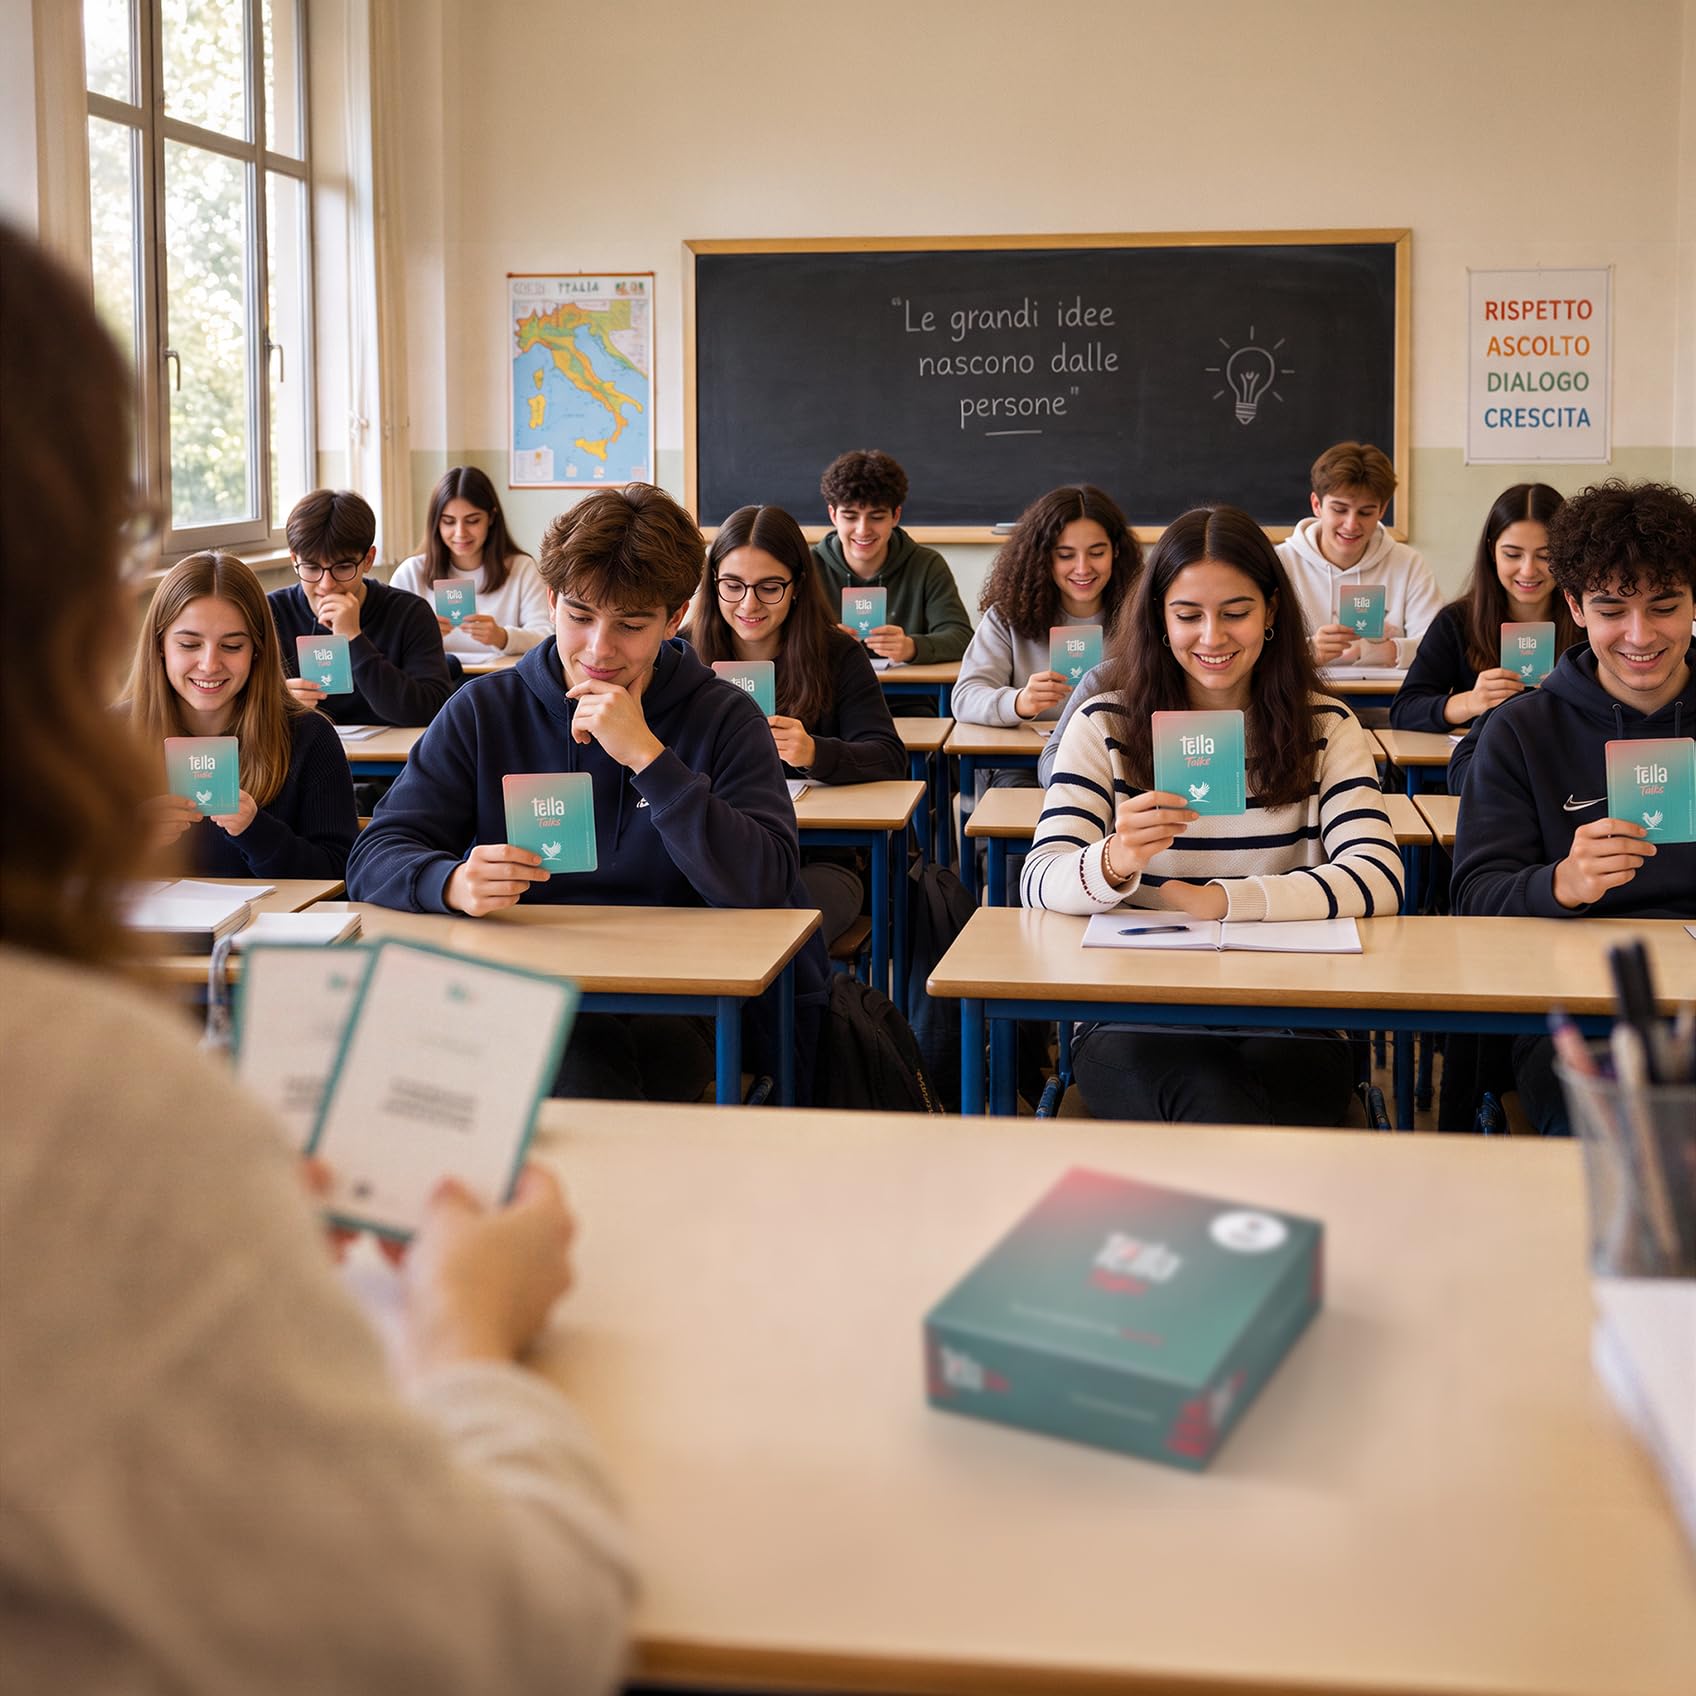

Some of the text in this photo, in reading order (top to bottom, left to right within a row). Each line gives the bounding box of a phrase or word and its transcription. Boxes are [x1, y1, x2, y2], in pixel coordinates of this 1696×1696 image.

[950, 297, 1039, 342] grandi
[1058, 295, 1116, 328] idee
[1485, 300, 1593, 321] RISPETTO
[1487, 335, 1591, 357] ASCOLTO
[920, 341, 1119, 376] nascono dalle
[1487, 371, 1590, 393] DIALOGO
[1484, 407, 1591, 429] CRESCITA
[1179, 734, 1215, 755] tella
[188, 754, 216, 771] tella
[1184, 756, 1211, 768] Talks
[1633, 763, 1668, 784] tella
[1640, 785, 1665, 796] Talks
[531, 796, 565, 817] tella
[537, 817, 561, 828] Talks
